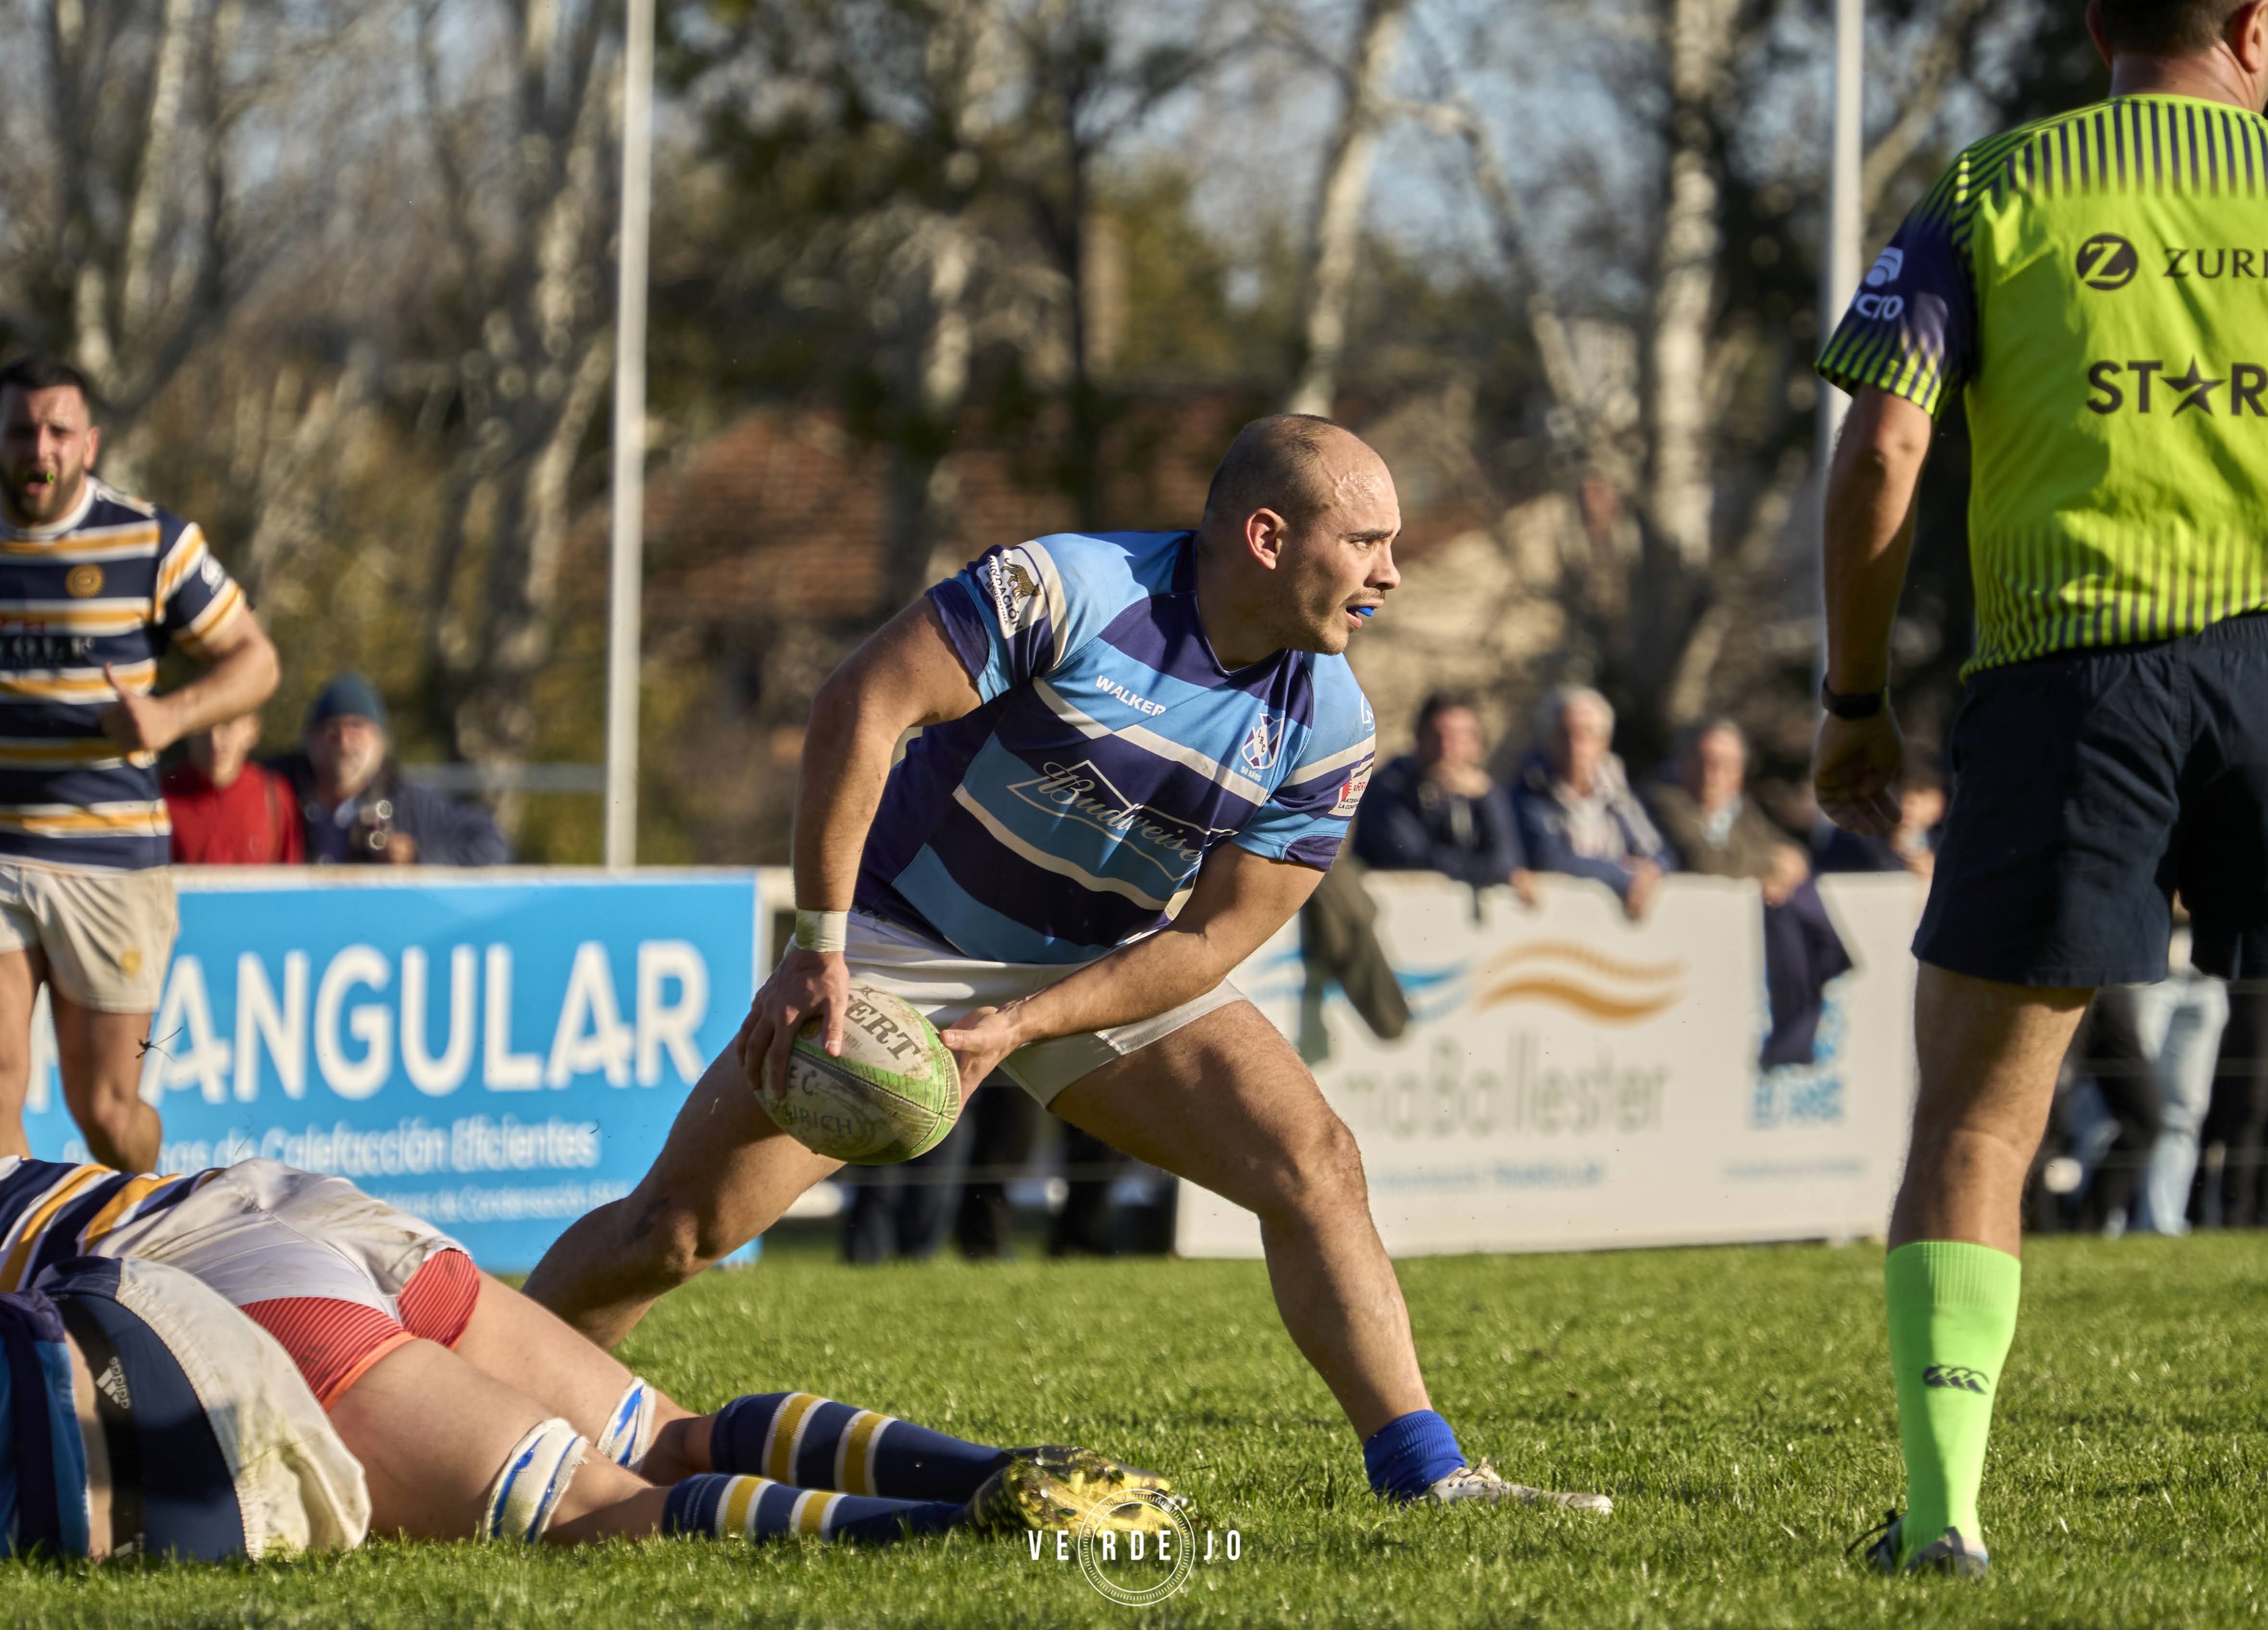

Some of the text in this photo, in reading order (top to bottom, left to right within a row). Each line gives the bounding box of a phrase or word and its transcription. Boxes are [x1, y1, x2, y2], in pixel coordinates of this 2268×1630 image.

[1849, 288, 1905, 321] cro
[988, 557, 1023, 631] UNDACIÓN
[1096, 675, 1167, 716] WALKER
[1240, 766, 1248, 775] 50
[27, 937, 710, 1113] ANGULAR
[844, 993, 922, 1060] ERT
[109, 1356, 131, 1409] adidas
